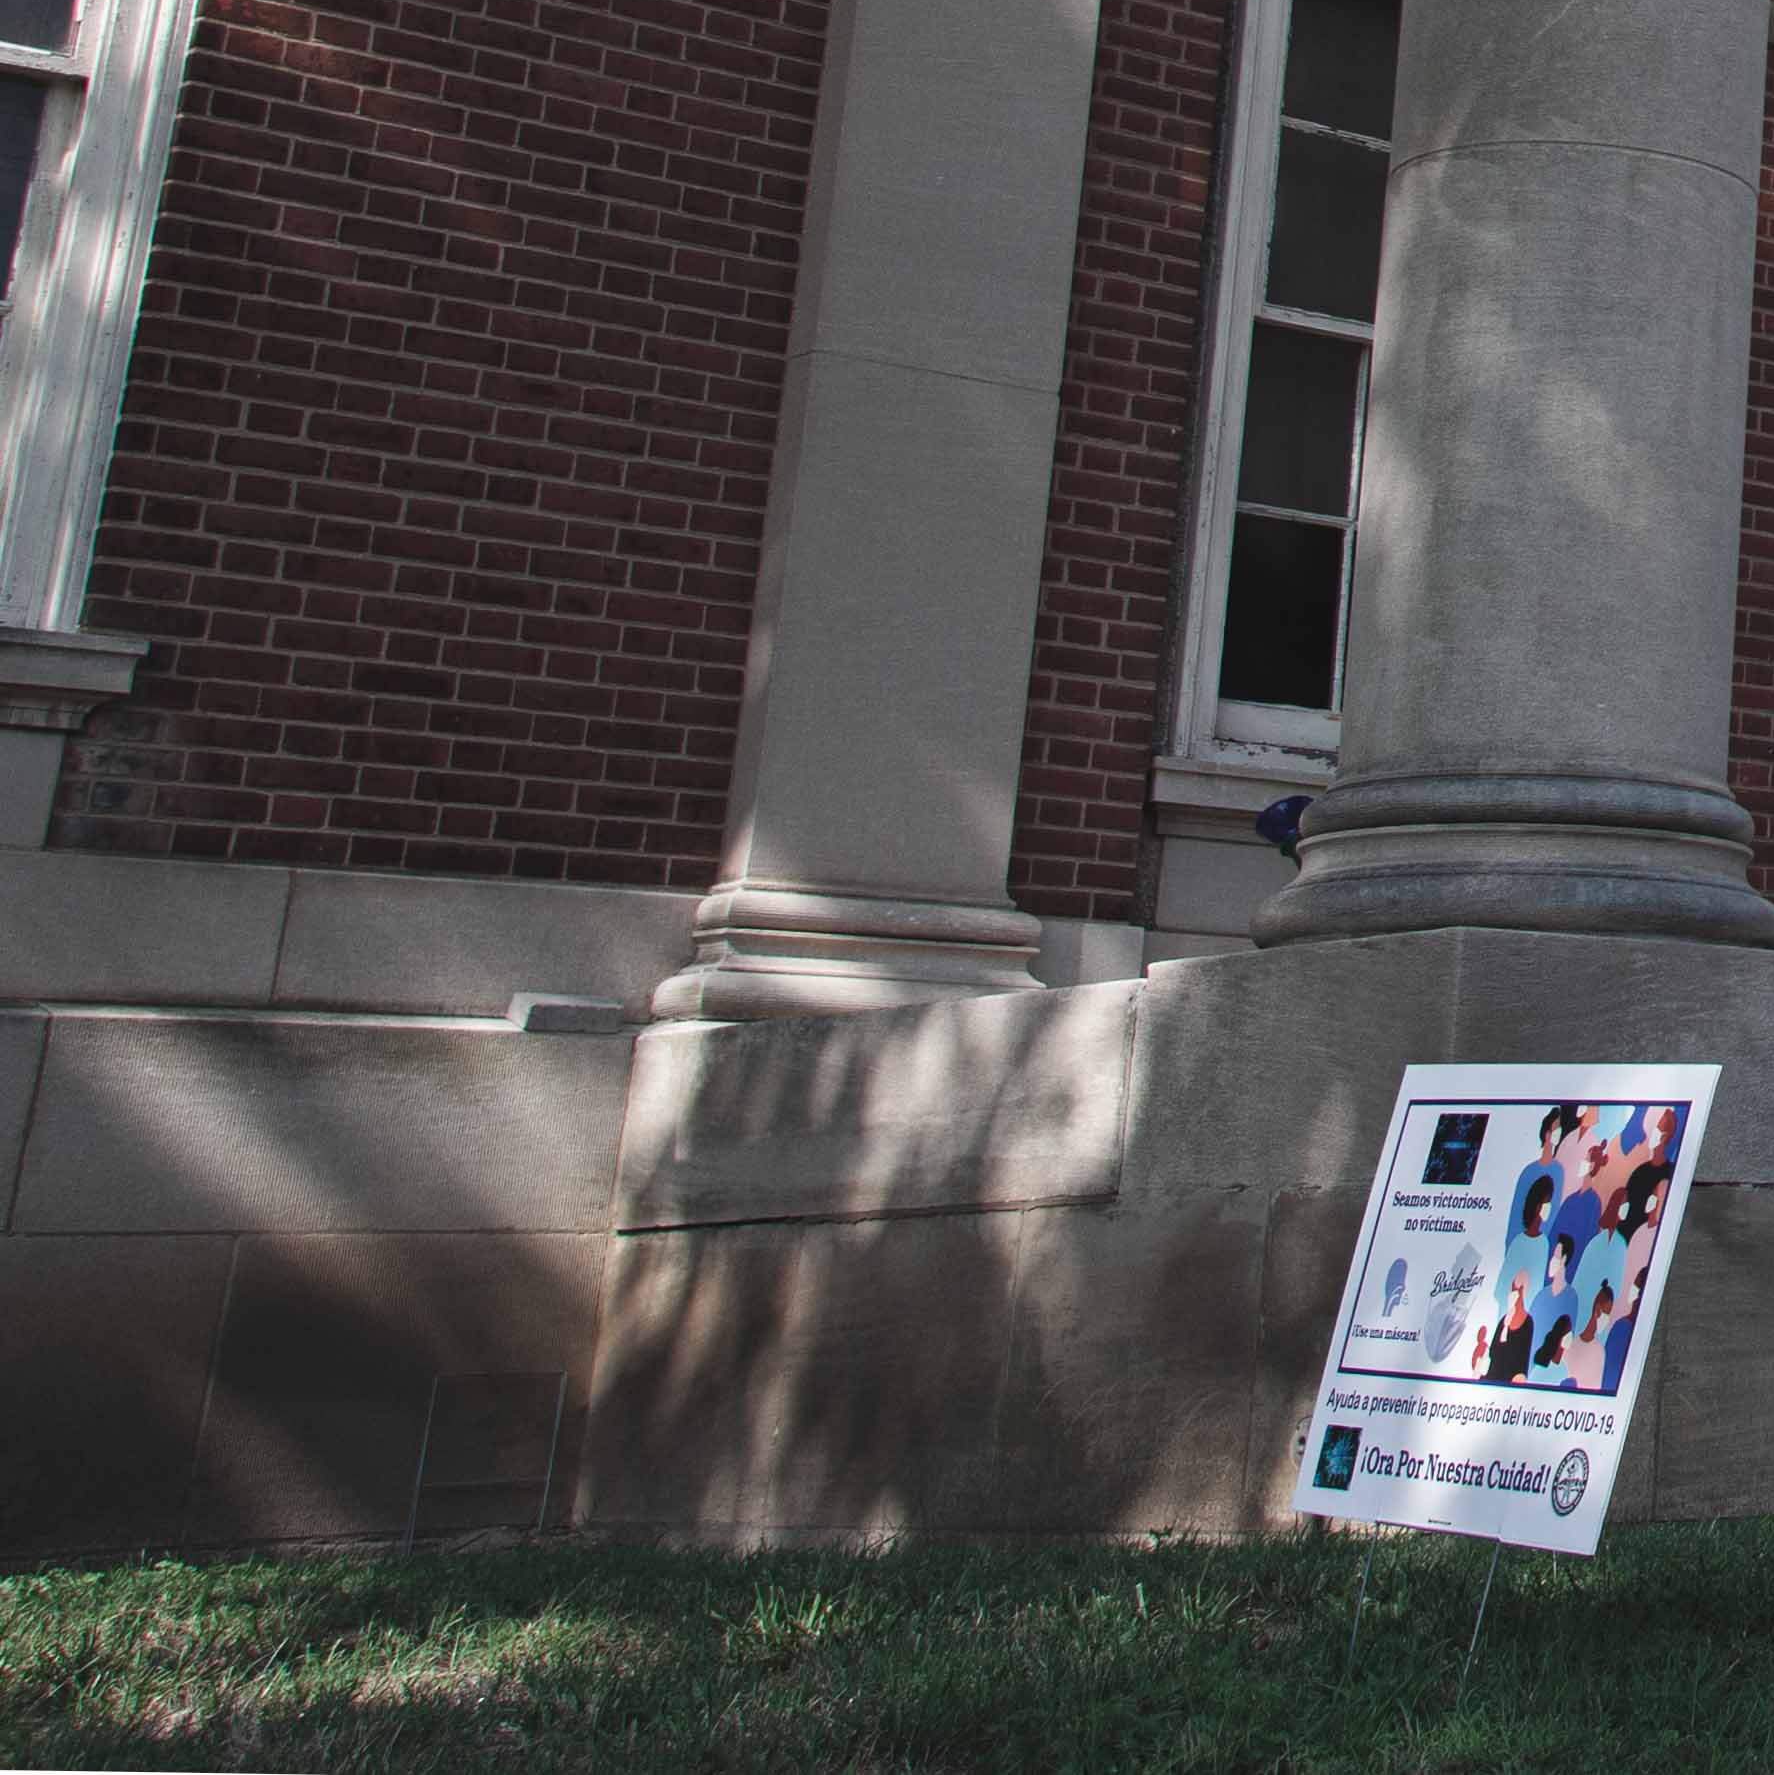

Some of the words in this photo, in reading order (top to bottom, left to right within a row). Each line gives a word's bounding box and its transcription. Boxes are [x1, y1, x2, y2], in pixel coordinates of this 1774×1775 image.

[1392, 1191, 1431, 1207] Seamos
[1433, 1192, 1492, 1211] victoriosos,
[1404, 1218, 1417, 1231] no
[1430, 1264, 1485, 1303] Bridgeton
[1370, 1329, 1383, 1338] una
[1327, 1389, 1360, 1412] Ayuda
[1361, 1396, 1369, 1406] a
[1370, 1396, 1417, 1415] prevenir
[1416, 1397, 1428, 1411] la
[1429, 1401, 1500, 1426] propagación
[1502, 1406, 1520, 1425] del
[1522, 1409, 1551, 1428] virus
[1554, 1409, 1615, 1435] COVID-19.
[1360, 1446, 1394, 1476] ¡Ora
[1398, 1450, 1423, 1478] Por
[1425, 1454, 1485, 1486] Nuestra
[1487, 1461, 1551, 1494] Cuidad!
